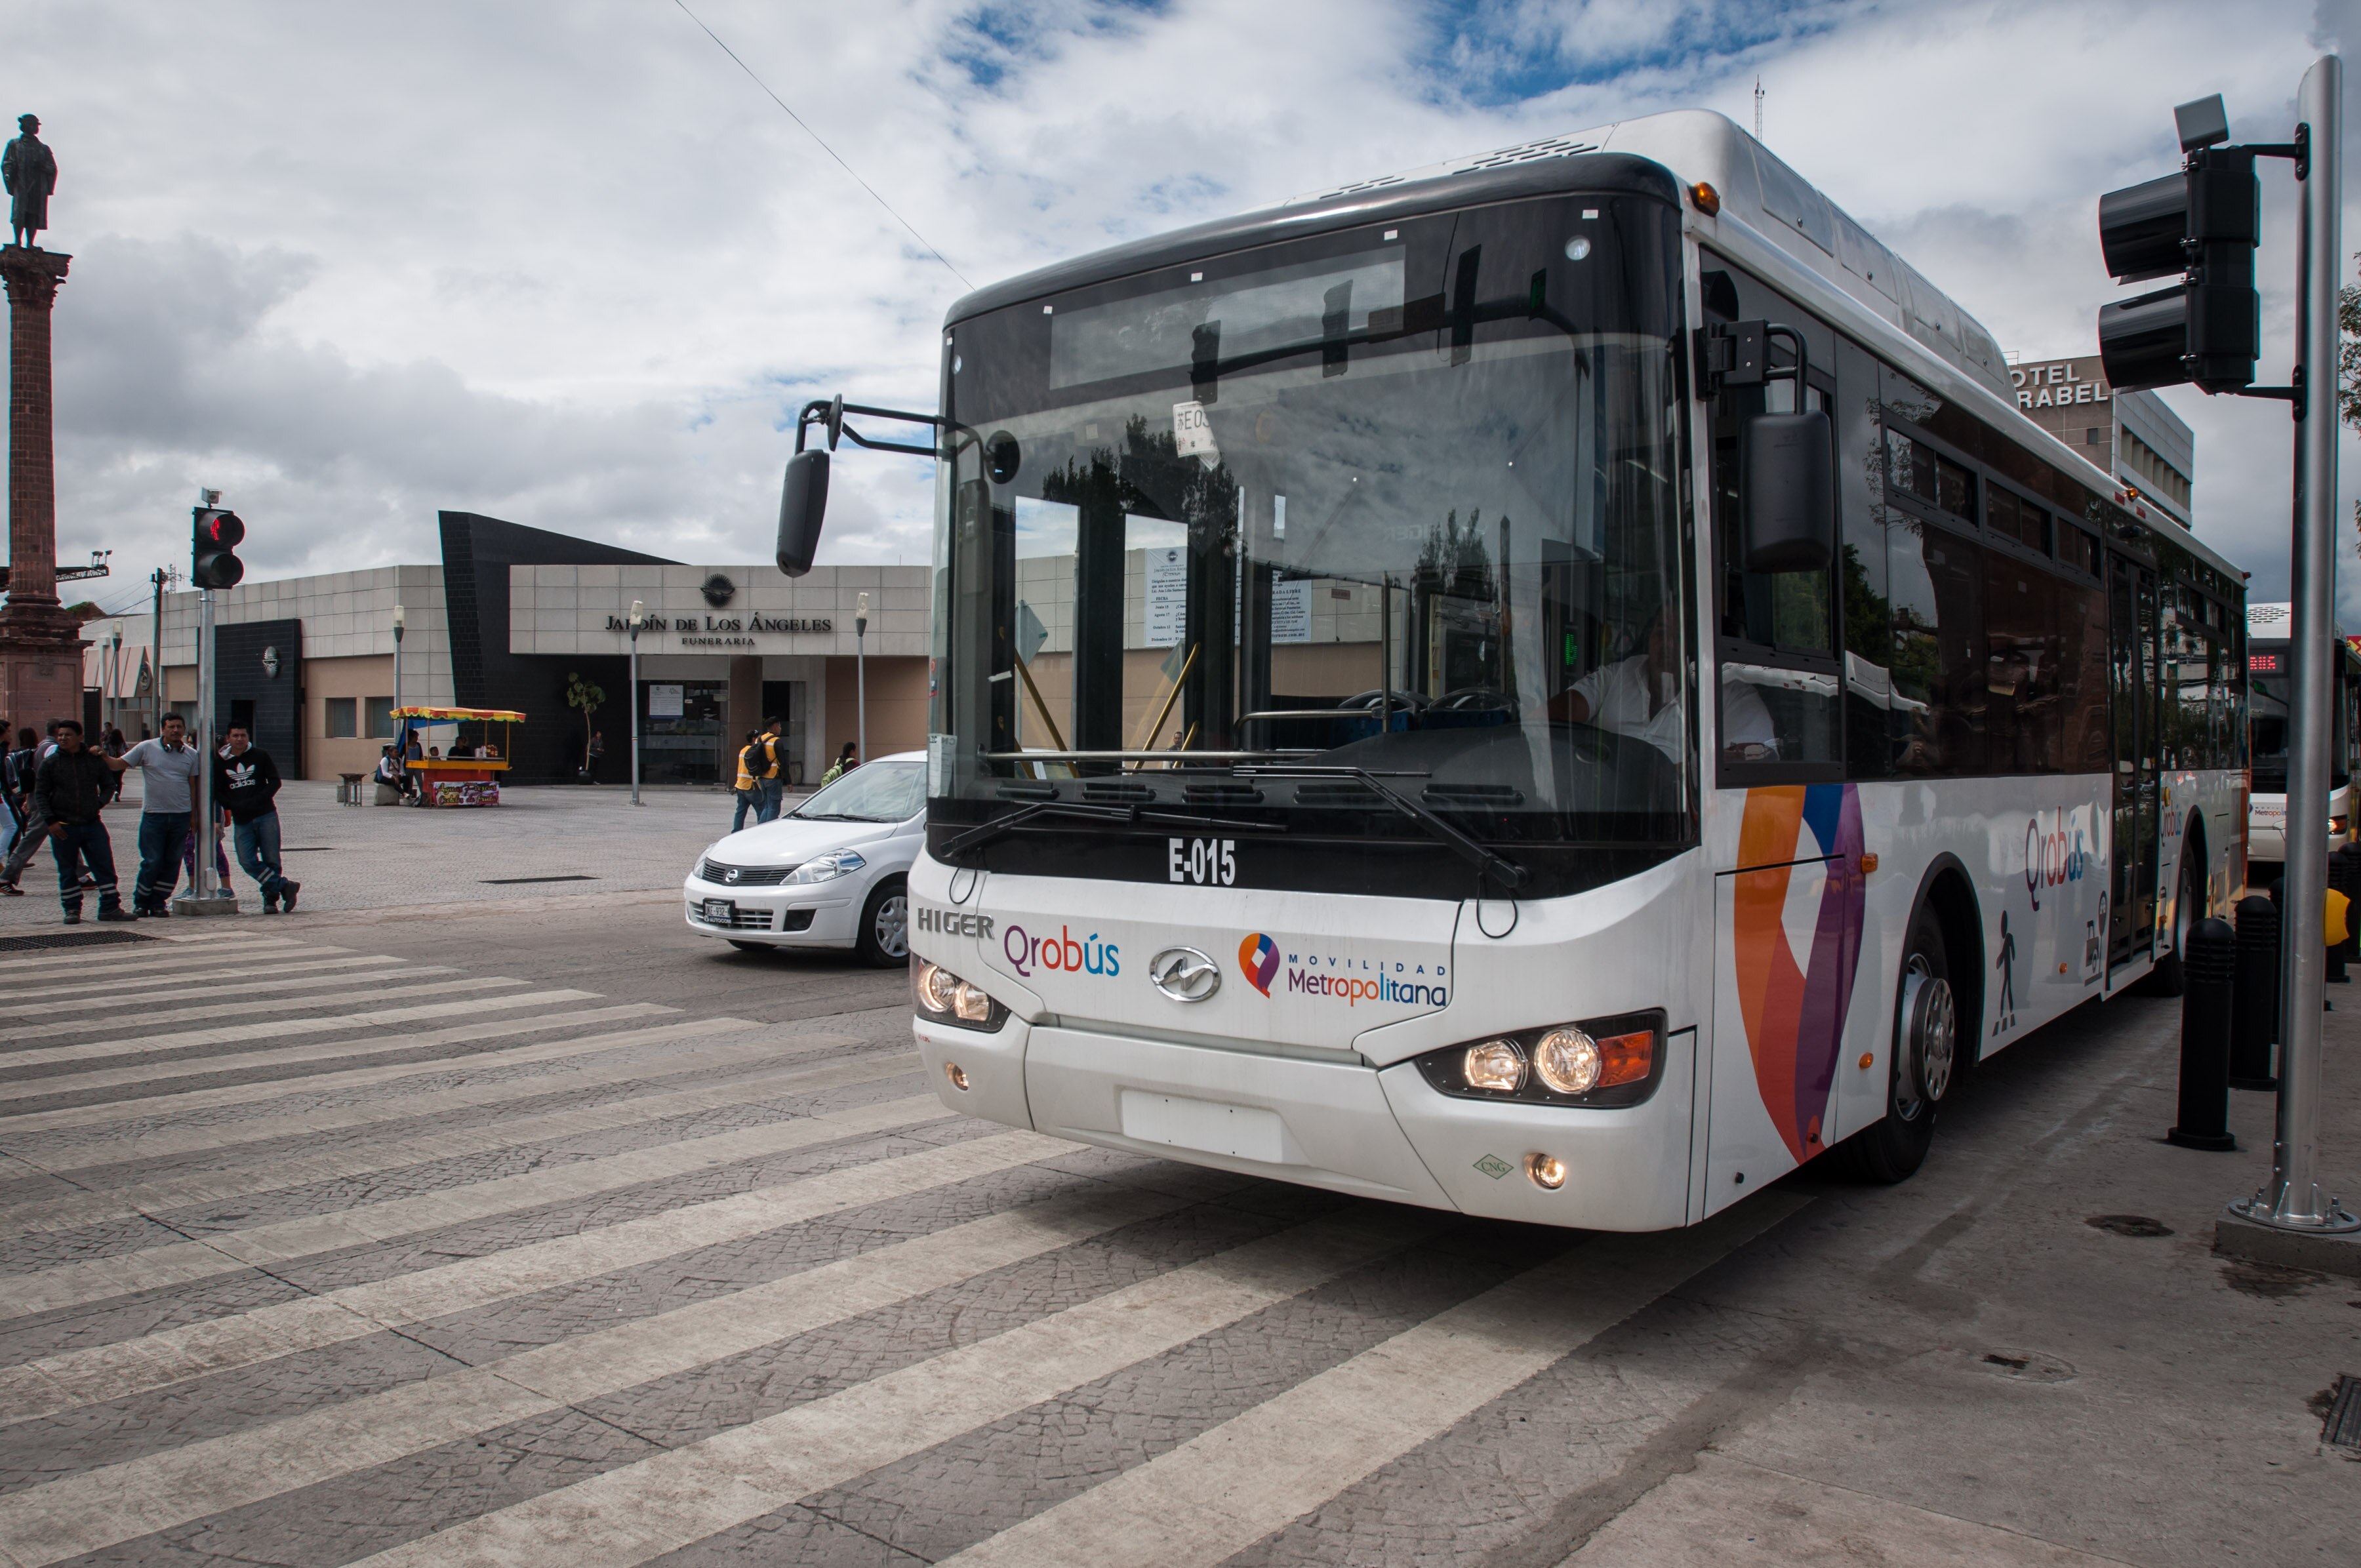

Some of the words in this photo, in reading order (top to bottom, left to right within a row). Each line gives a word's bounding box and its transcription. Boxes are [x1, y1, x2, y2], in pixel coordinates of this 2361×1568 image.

[676, 619, 697, 630] DE
[705, 616, 740, 630] LOS
[748, 612, 831, 631] ÁNGELES
[230, 779, 256, 790] adidas
[1169, 838, 1236, 885] E-015
[2025, 806, 2084, 912] Qrobús
[918, 906, 995, 940] HIGER
[1004, 925, 1120, 977] Qrobús
[1289, 954, 1445, 976] MOVILIDAD
[1289, 967, 1446, 1007] Metropolitana
[1482, 1162, 1505, 1172] CNG
